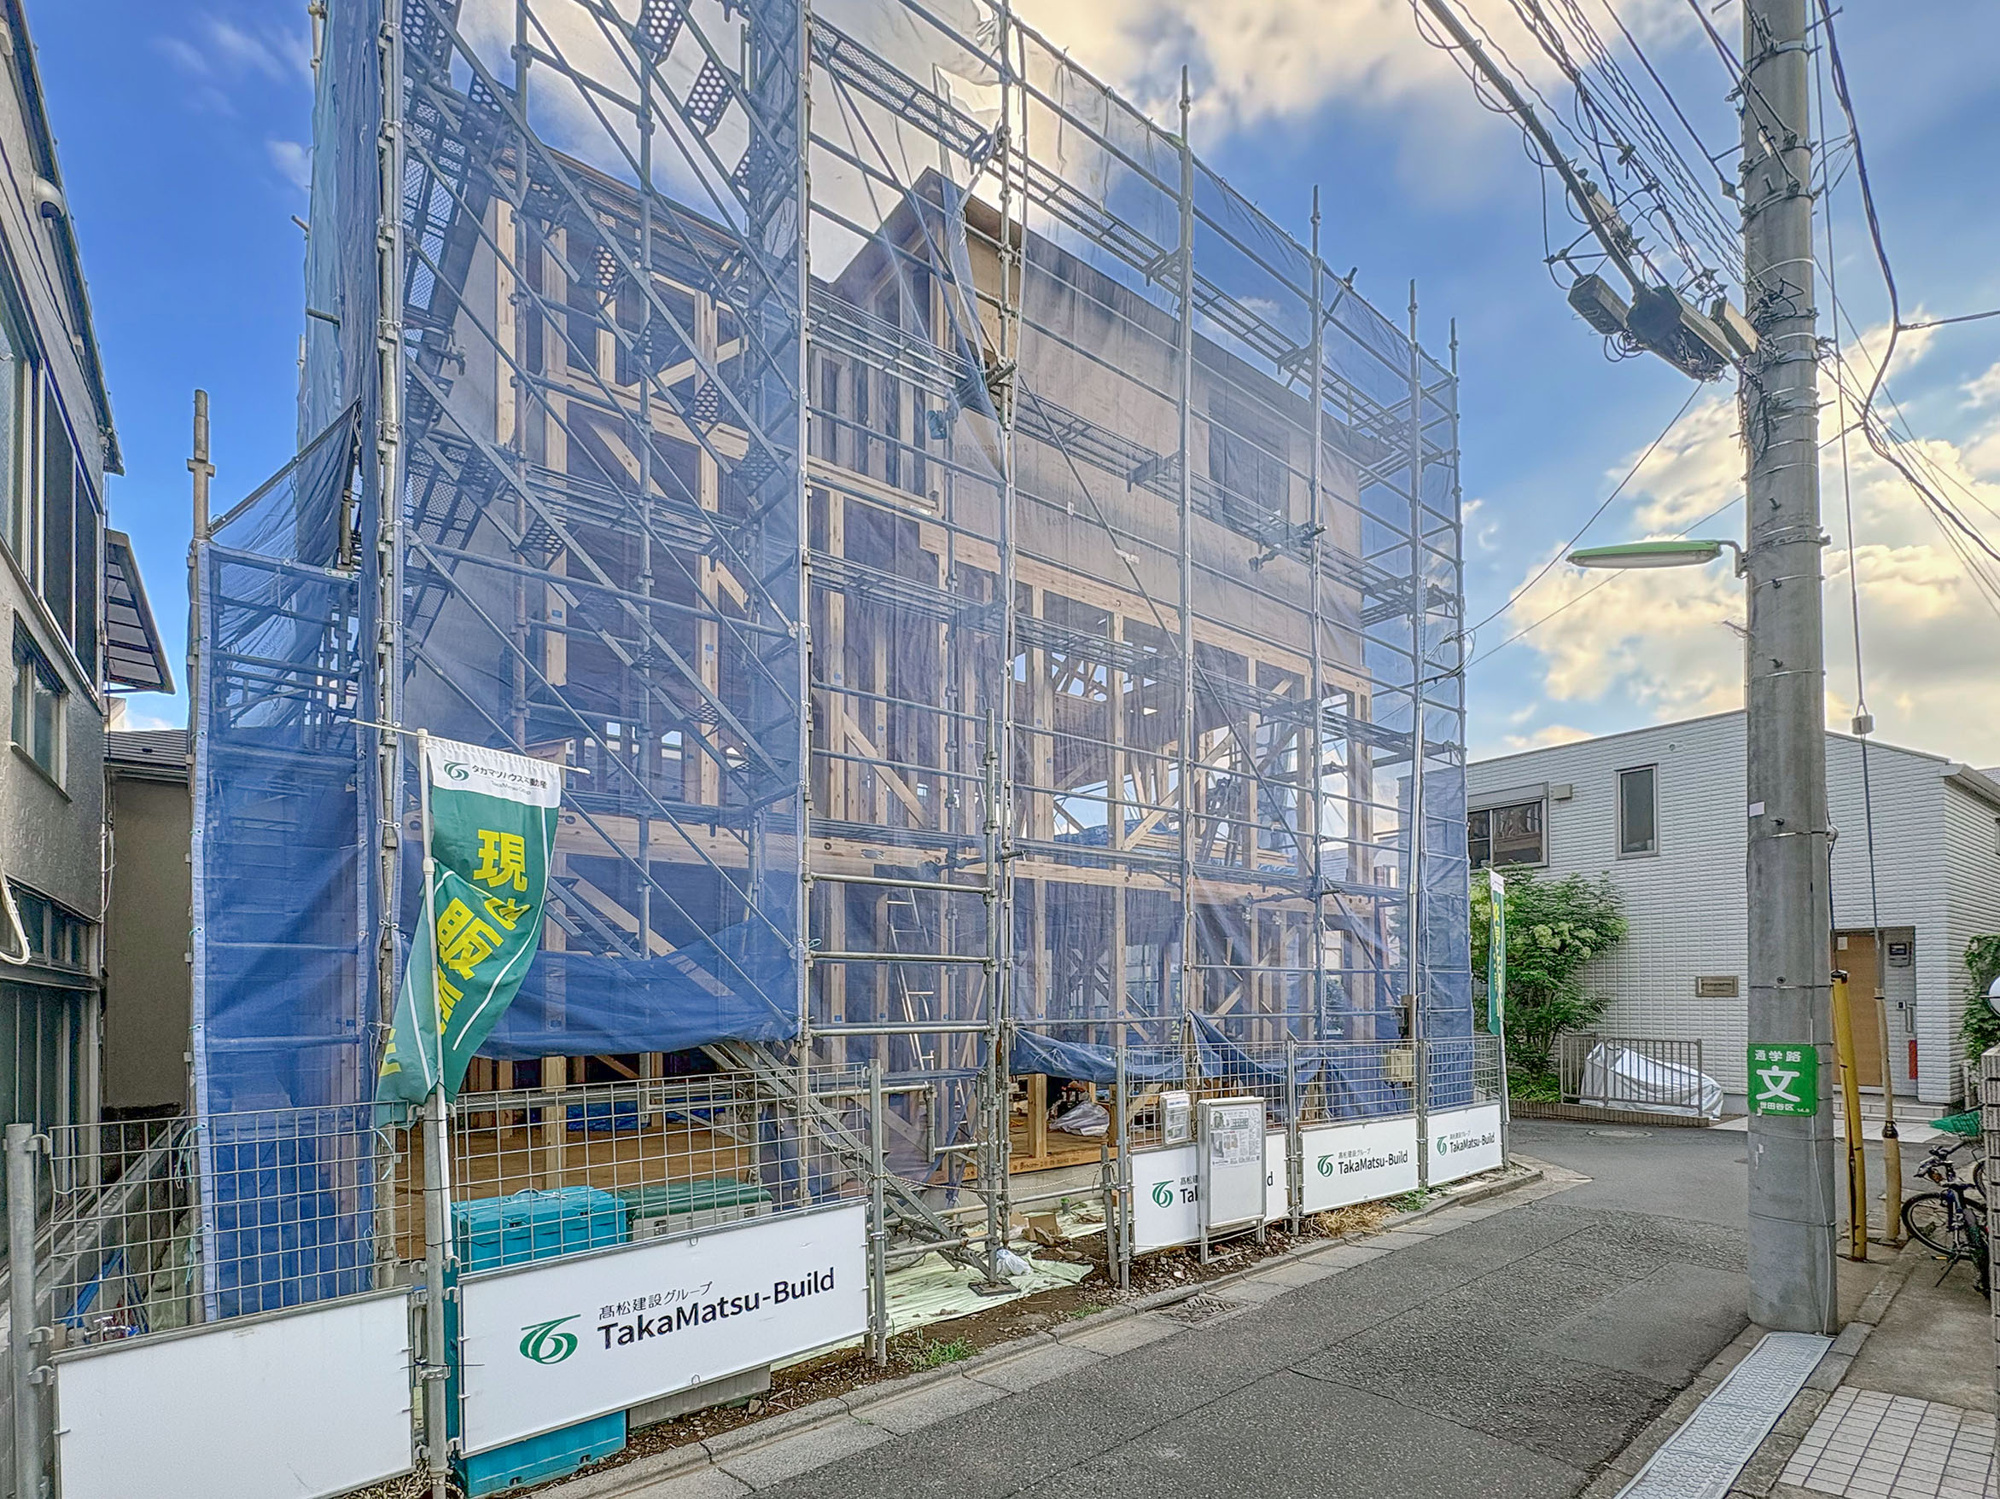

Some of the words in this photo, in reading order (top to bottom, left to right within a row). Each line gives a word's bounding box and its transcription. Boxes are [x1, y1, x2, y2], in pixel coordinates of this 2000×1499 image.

[1755, 1049, 1801, 1062] 通学路
[1756, 1065, 1801, 1102] 文
[1338, 1150, 1408, 1175] TakaMatsu-Build
[597, 1267, 835, 1350] TakaMatsu-Build
